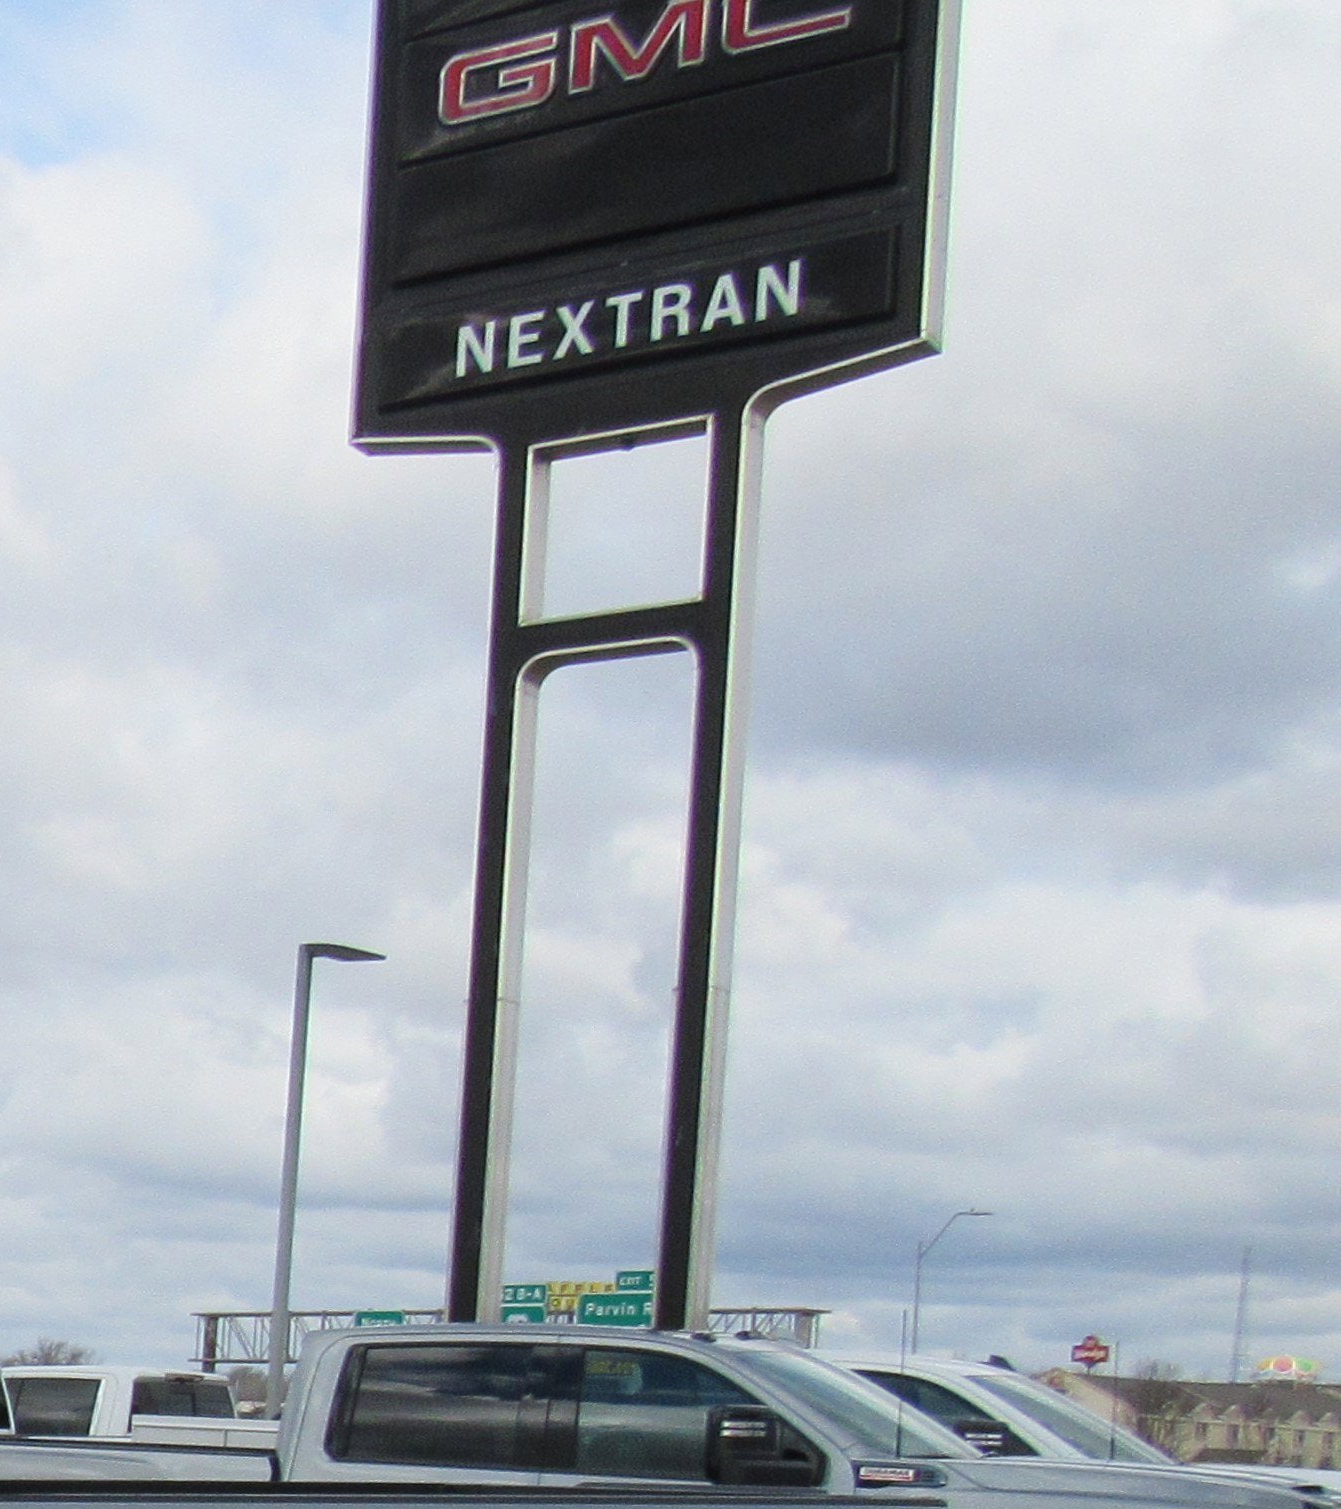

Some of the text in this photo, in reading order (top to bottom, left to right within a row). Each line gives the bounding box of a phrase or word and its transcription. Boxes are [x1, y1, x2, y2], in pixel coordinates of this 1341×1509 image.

[439, 0, 852, 126] GMC
[454, 258, 804, 378] NEXTRAN
[584, 1302, 635, 1316] Parvin
